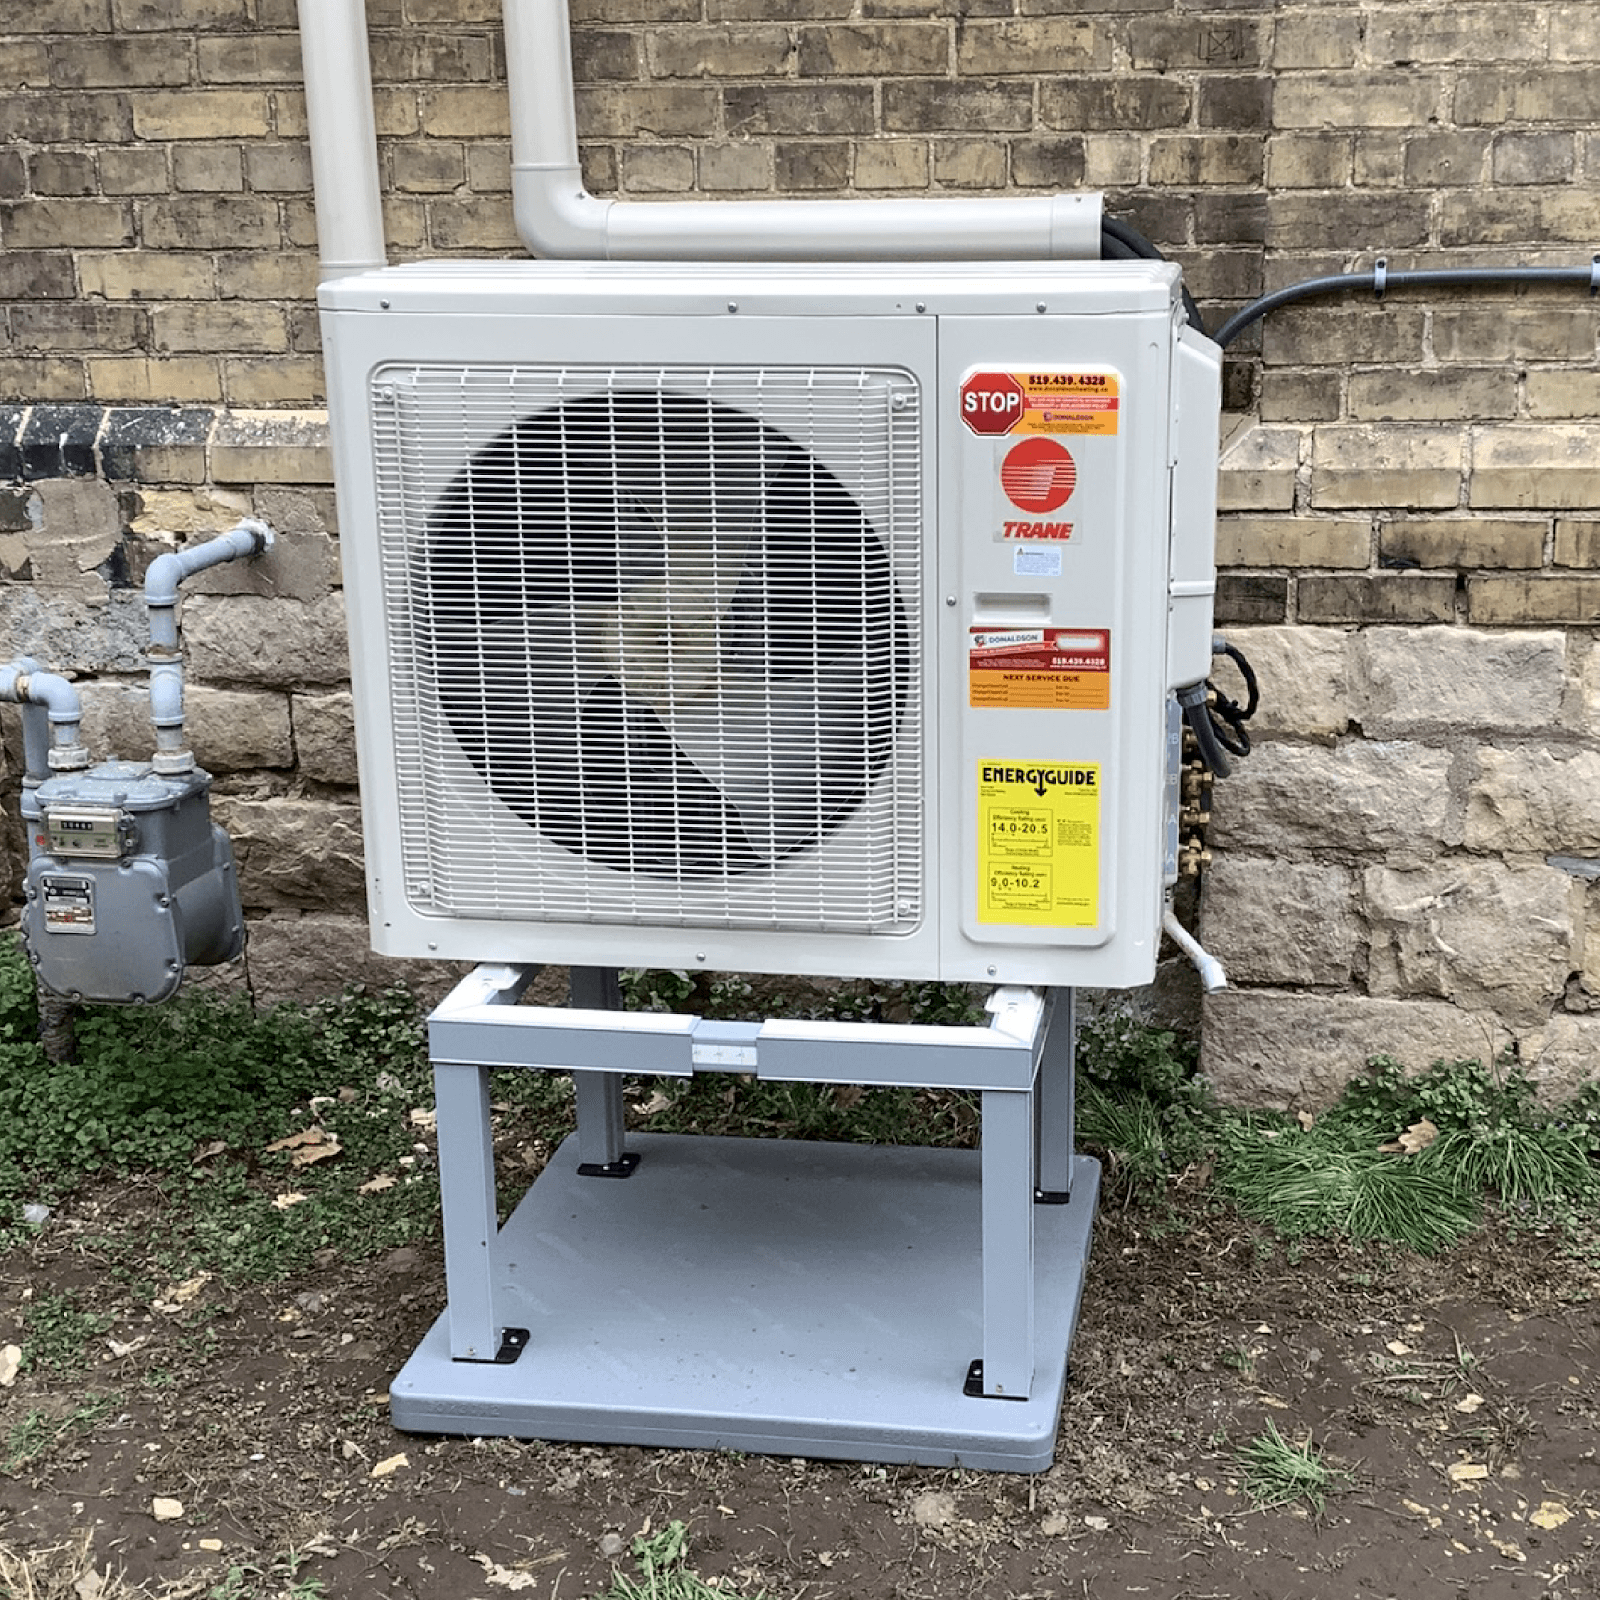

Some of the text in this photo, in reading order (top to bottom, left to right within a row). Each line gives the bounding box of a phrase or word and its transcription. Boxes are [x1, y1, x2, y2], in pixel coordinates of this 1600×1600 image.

[964, 391, 1020, 413] STOP
[1003, 521, 1074, 539] TRANE
[988, 634, 1039, 644] DONALDSON
[1002, 674, 1081, 683] NEXT SERVICE DUE
[982, 767, 1096, 787] ENERGYGUIDE
[991, 822, 1048, 834] 14.0-20.5
